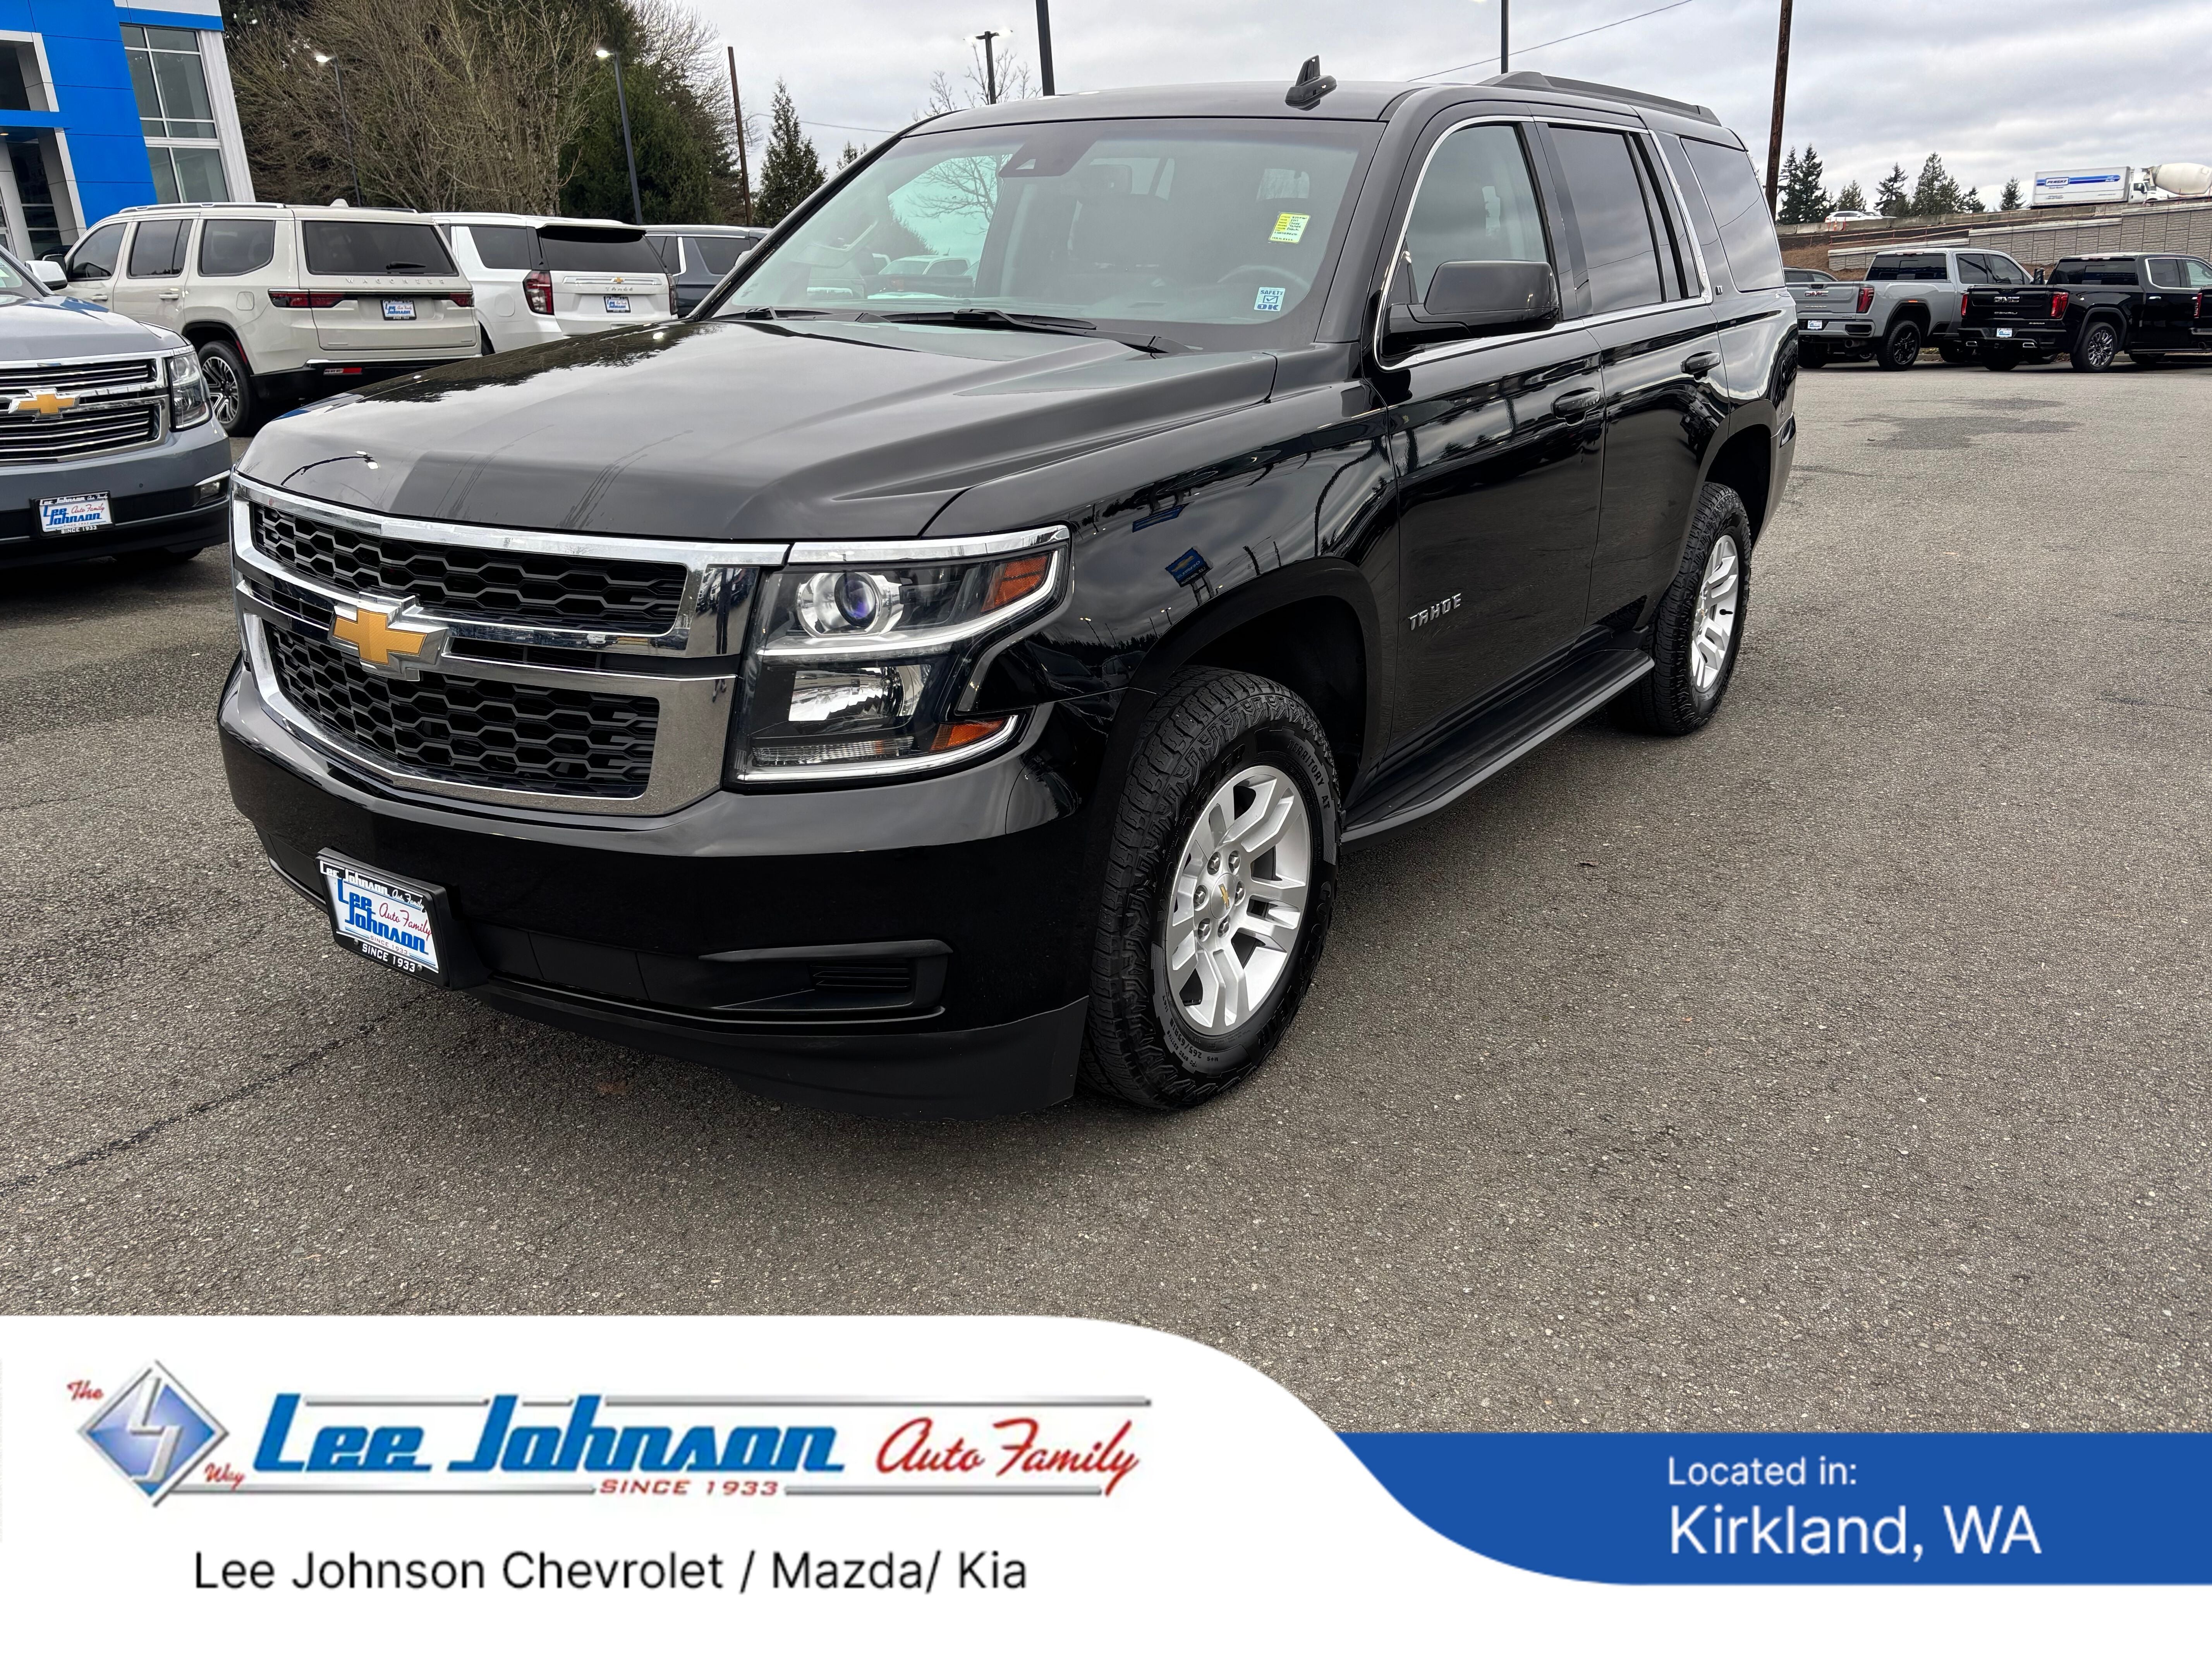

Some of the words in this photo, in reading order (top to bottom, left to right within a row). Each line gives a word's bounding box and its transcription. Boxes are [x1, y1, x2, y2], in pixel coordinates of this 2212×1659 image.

[43, 505, 69, 517] Lee
[46, 512, 102, 526] Johnson
[71, 505, 85, 514] Auto
[86, 503, 105, 513] Family
[1408, 593, 1461, 630] TAHOE
[1288, 739, 1324, 786] TERRITORY
[1321, 795, 1331, 809] AT
[320, 860, 342, 879] Lee
[343, 869, 390, 900] Johnson
[392, 889, 405, 902] Auto
[405, 893, 426, 913] Family
[338, 878, 376, 915] Lee
[345, 905, 429, 955] Johnson
[379, 903, 400, 922] Auto
[400, 910, 432, 941] Family
[362, 943, 389, 962] SINCE
[392, 957, 415, 973] 1933
[370, 936, 389, 947] SINCE
[392, 943, 408, 955] 1933
[1170, 1018, 1202, 1058] 265/65R18
